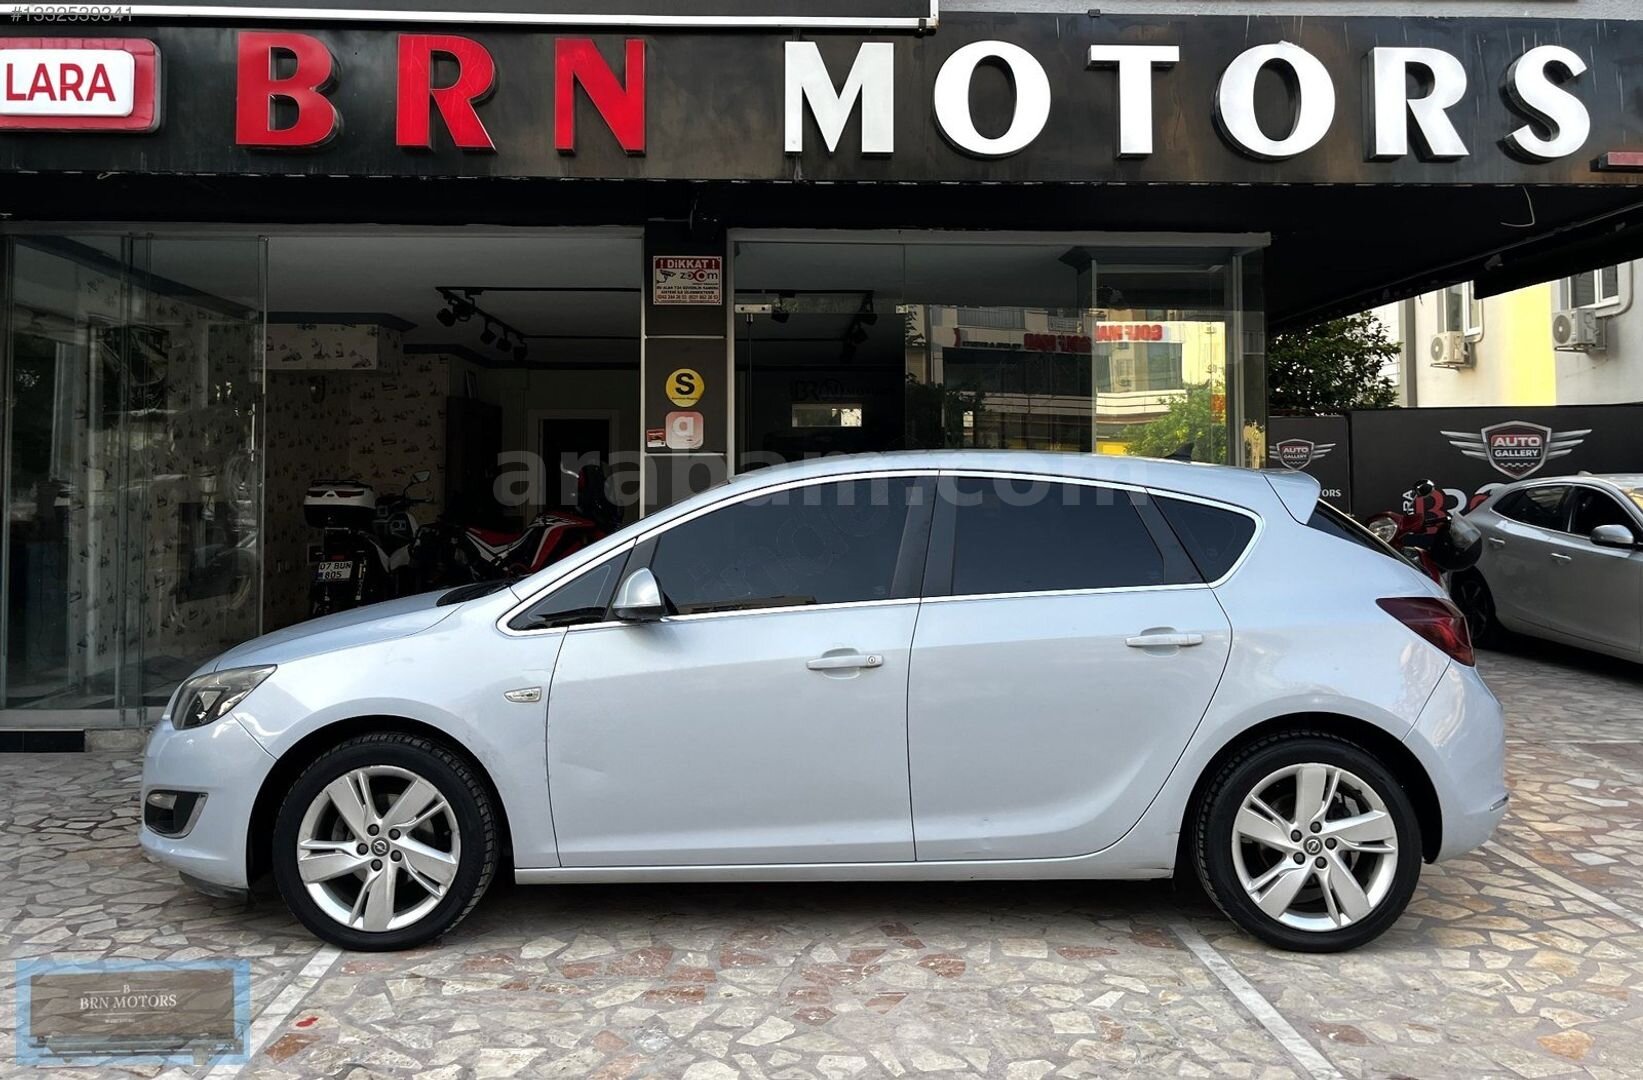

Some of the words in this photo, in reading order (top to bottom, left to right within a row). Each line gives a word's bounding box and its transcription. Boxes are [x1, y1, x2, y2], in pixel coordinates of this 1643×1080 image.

[6, 63, 116, 102] LARA
[235, 31, 646, 155] BRN
[784, 40, 1591, 161] MOTORS
[675, 372, 695, 395] S
[1493, 436, 1541, 447] AUTO
[1494, 449, 1539, 457] GALLERY
[1321, 488, 1342, 498] ORS
